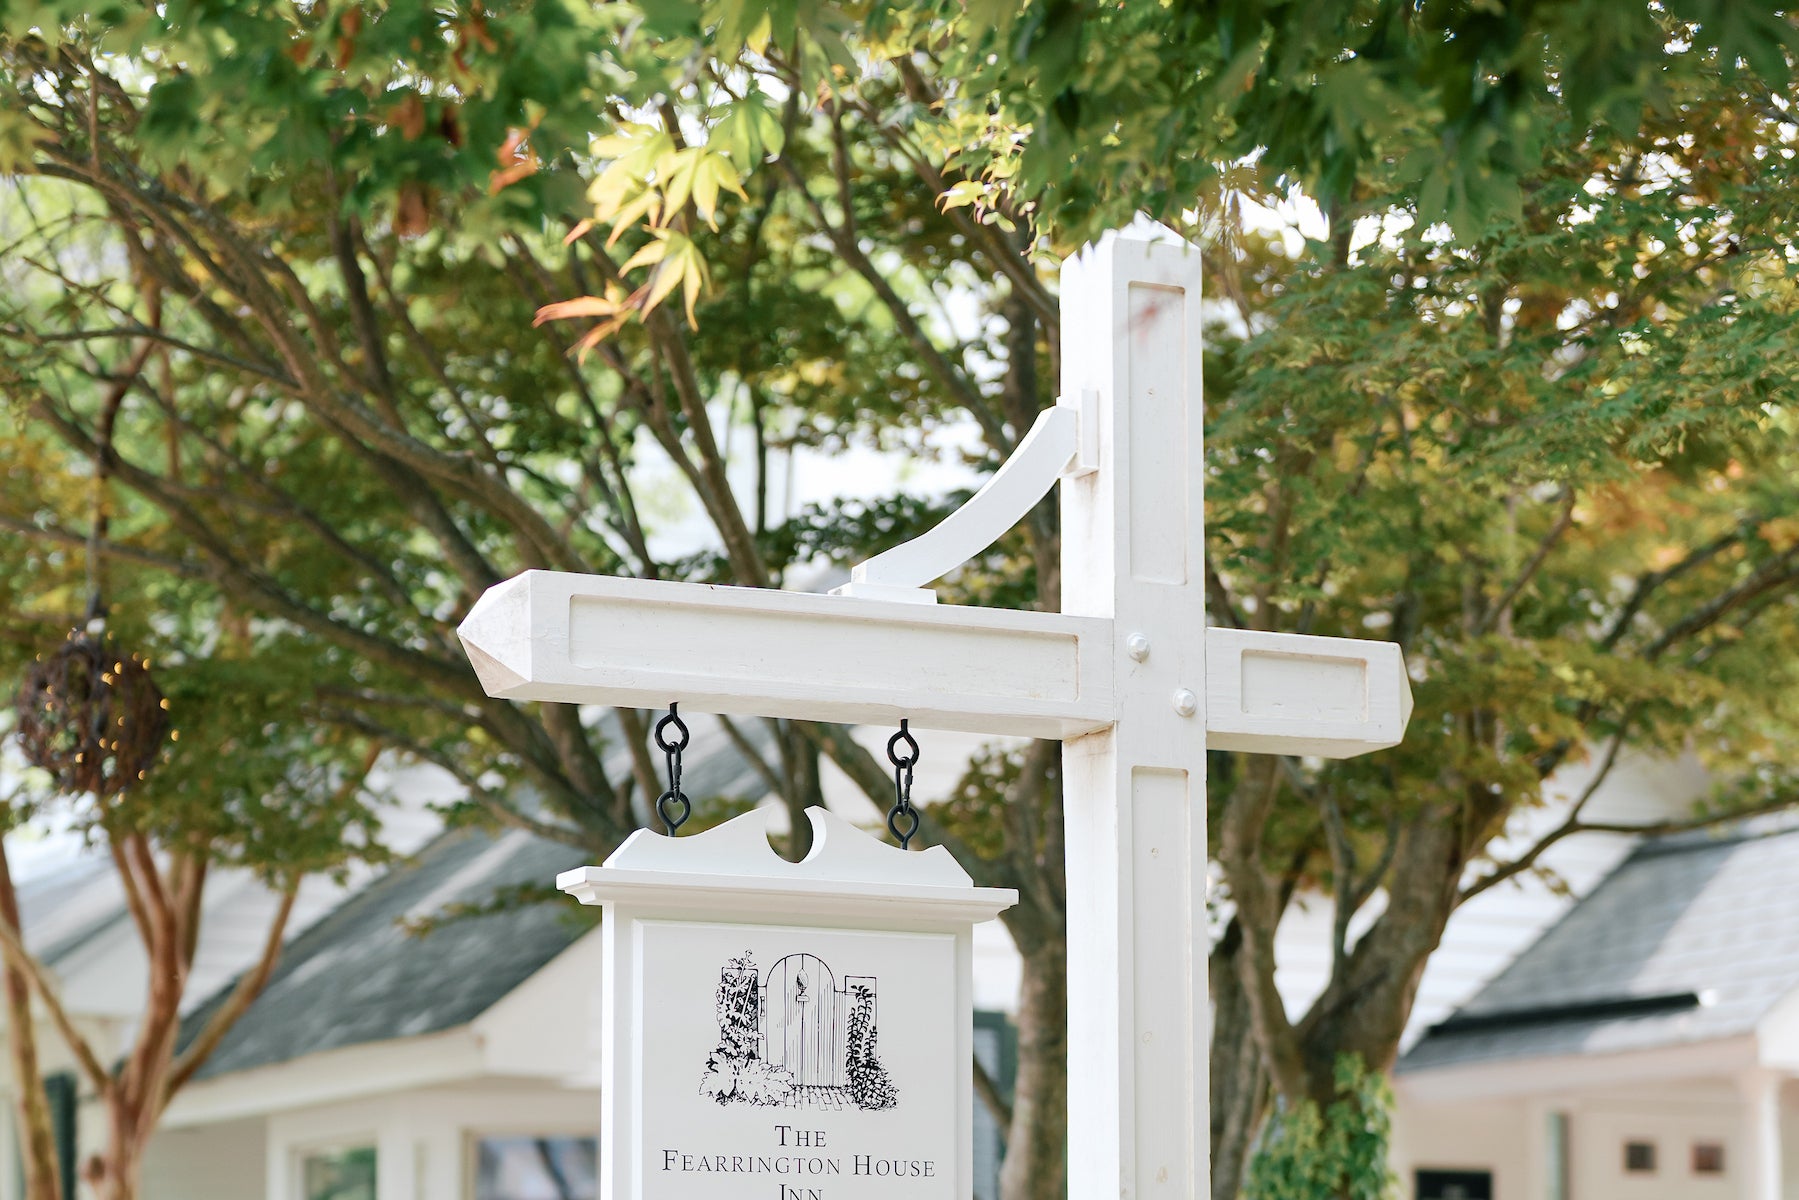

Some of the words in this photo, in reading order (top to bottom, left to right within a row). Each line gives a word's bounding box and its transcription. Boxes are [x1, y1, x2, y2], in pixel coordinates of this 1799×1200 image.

[774, 1125, 828, 1148] THE
[662, 1149, 841, 1175] FEARRINGTON
[853, 1154, 936, 1177] HOUSE
